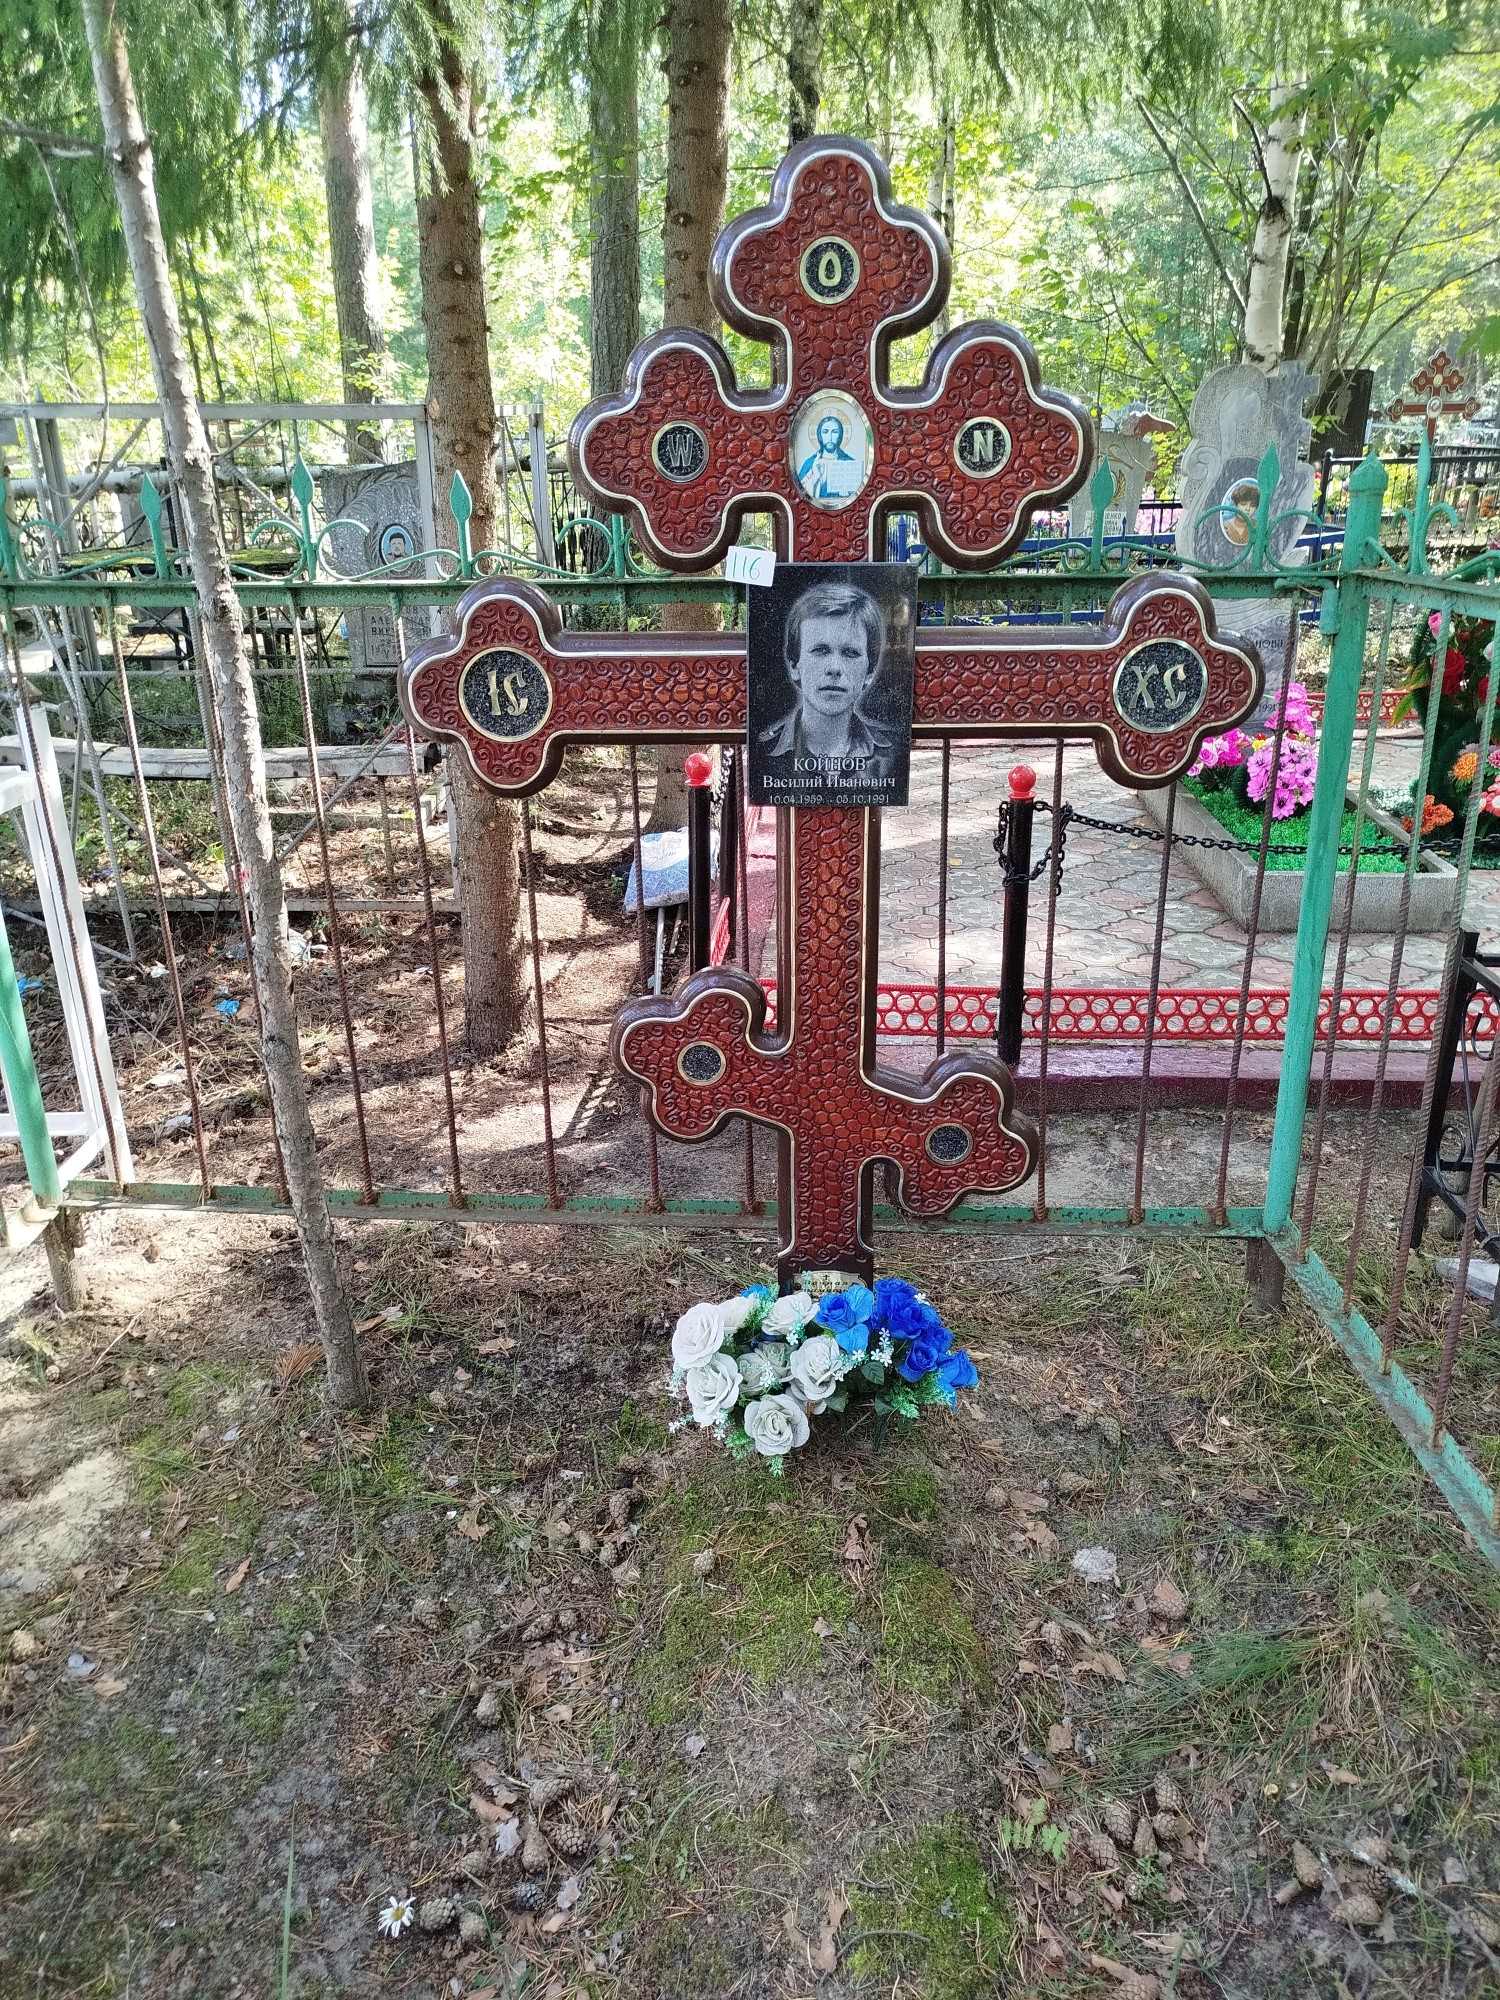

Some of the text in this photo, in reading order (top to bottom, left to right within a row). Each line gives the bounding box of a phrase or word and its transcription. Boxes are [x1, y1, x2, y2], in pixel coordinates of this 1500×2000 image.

[732, 552, 762, 580] 116
[794, 754, 866, 772] КОЙНОВ
[763, 775, 896, 788] Василий Иванович
[769, 794, 890, 804] 10.04.1959 05.10.1991
